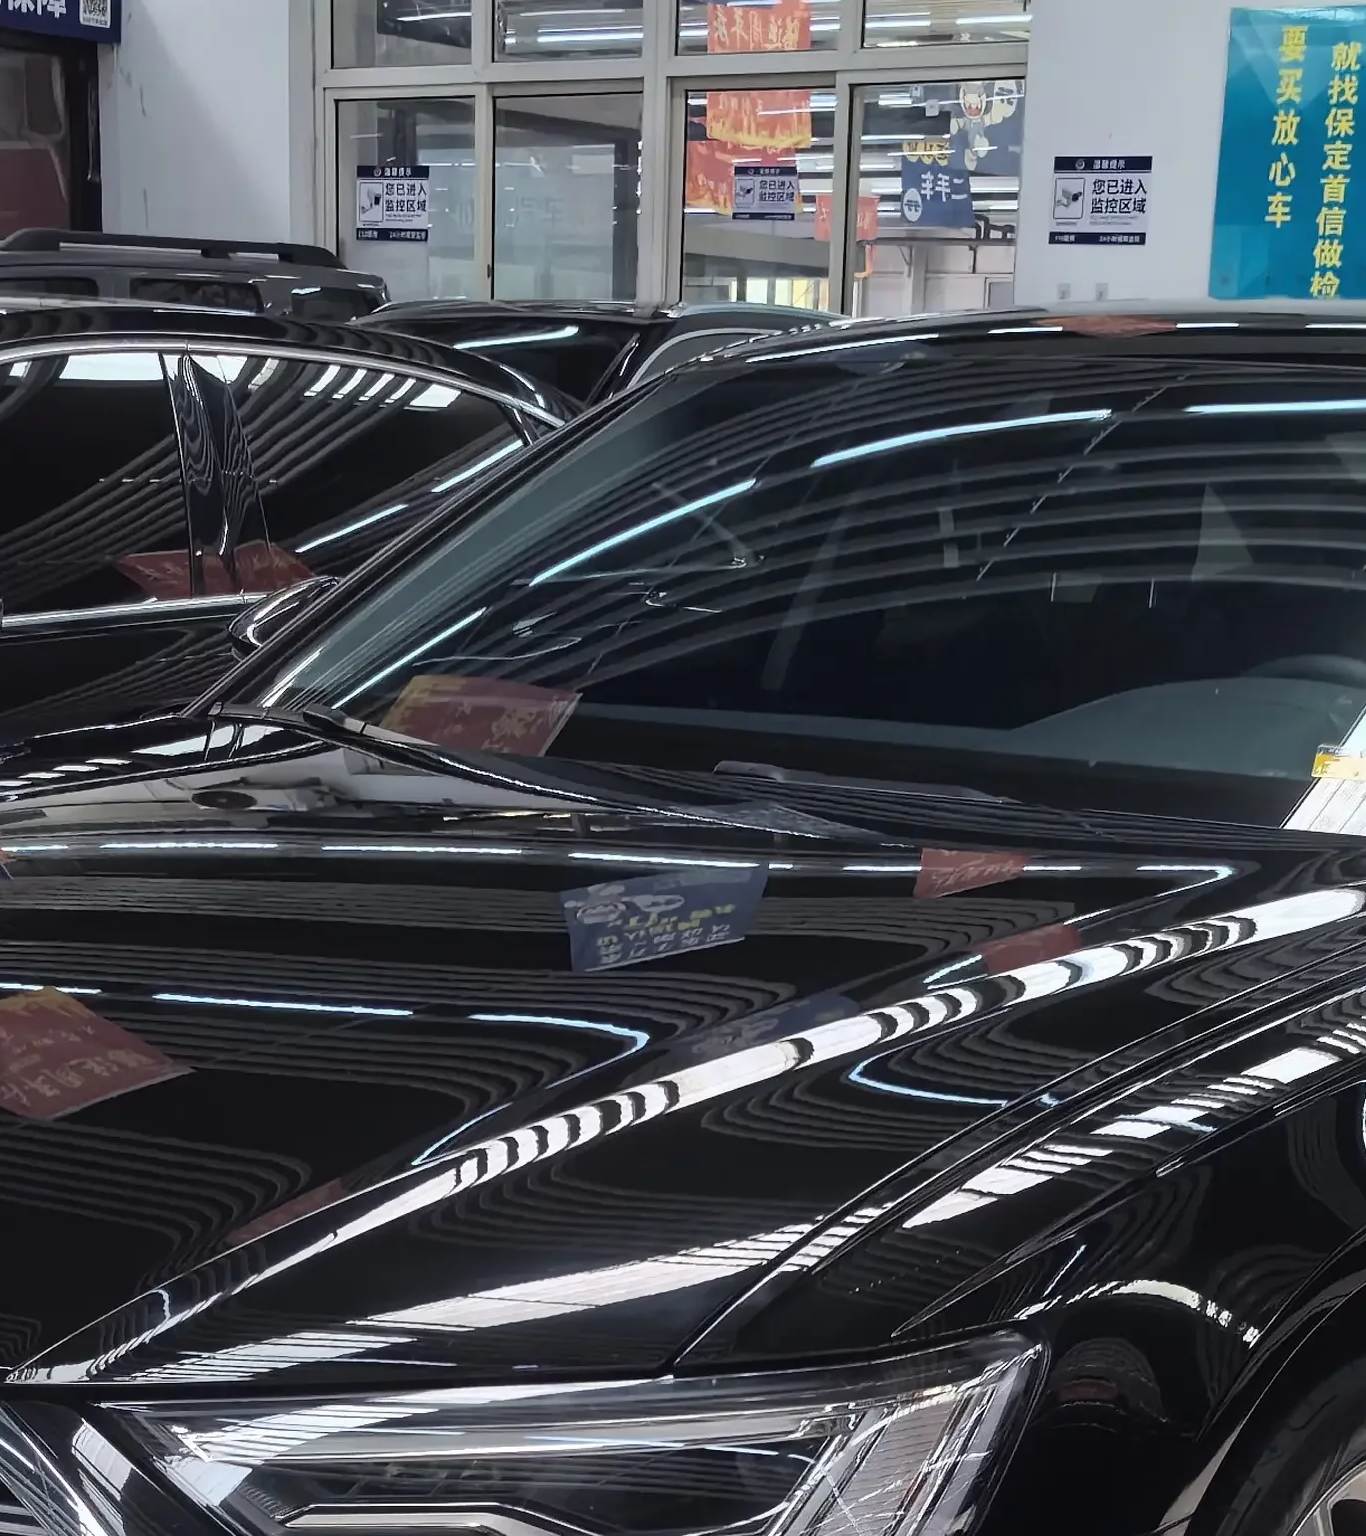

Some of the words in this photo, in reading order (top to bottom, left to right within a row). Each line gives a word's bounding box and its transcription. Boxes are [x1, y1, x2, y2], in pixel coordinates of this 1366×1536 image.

[1265, 25, 1308, 228] 要买放心车
[1310, 41, 1363, 298] 就找保定首信做检
[385, 182, 427, 197] 您已进入
[1091, 178, 1147, 195] 您已进入
[385, 199, 427, 212] 监控区域
[1090, 197, 1147, 214] 监控区域
